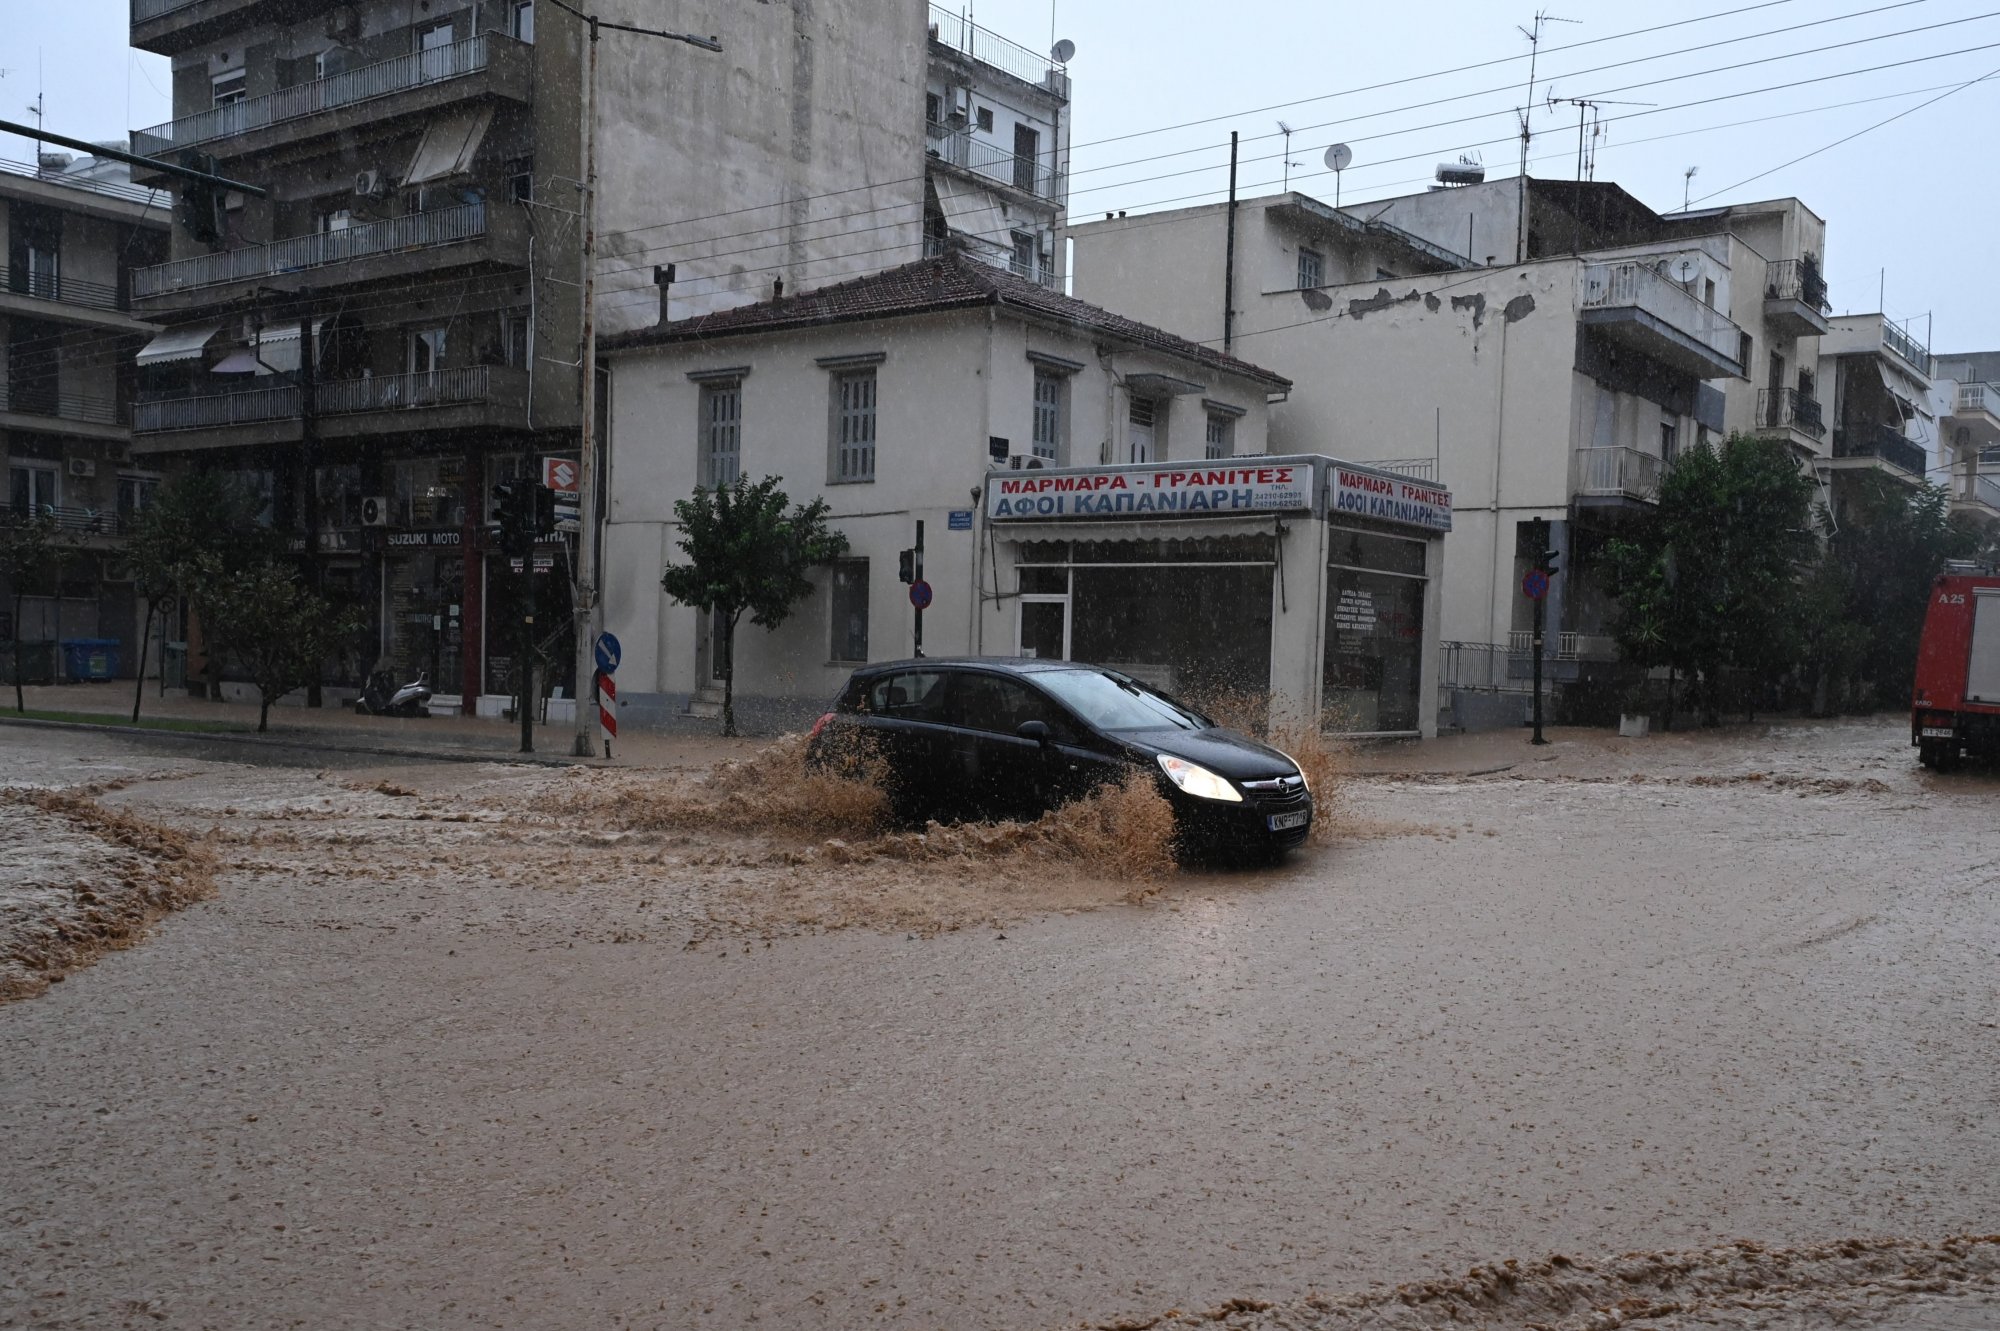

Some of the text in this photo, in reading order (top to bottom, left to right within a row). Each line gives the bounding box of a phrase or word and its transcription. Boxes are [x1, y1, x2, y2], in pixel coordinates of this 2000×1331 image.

[1001, 475, 1127, 494] ΜΑΡΜΑΡΑ
[1154, 468, 1293, 488] ΓΡΑΝΙΤΕΣ
[1340, 472, 1449, 507] ΜΑΡΜΑΡΑ ΓΡΑΝΙΤΕΣ
[995, 489, 1252, 516] ΑΦΟΙ ΚΑΠΑΝΙΑΡΗ
[1338, 490, 1366, 511] ΑΦΟΙ
[1371, 497, 1433, 525] ΚΑΠΑΝΙΑΡΗ
[388, 532, 460, 545] SUZUKI MOTO
[1950, 594, 1965, 604] 25
